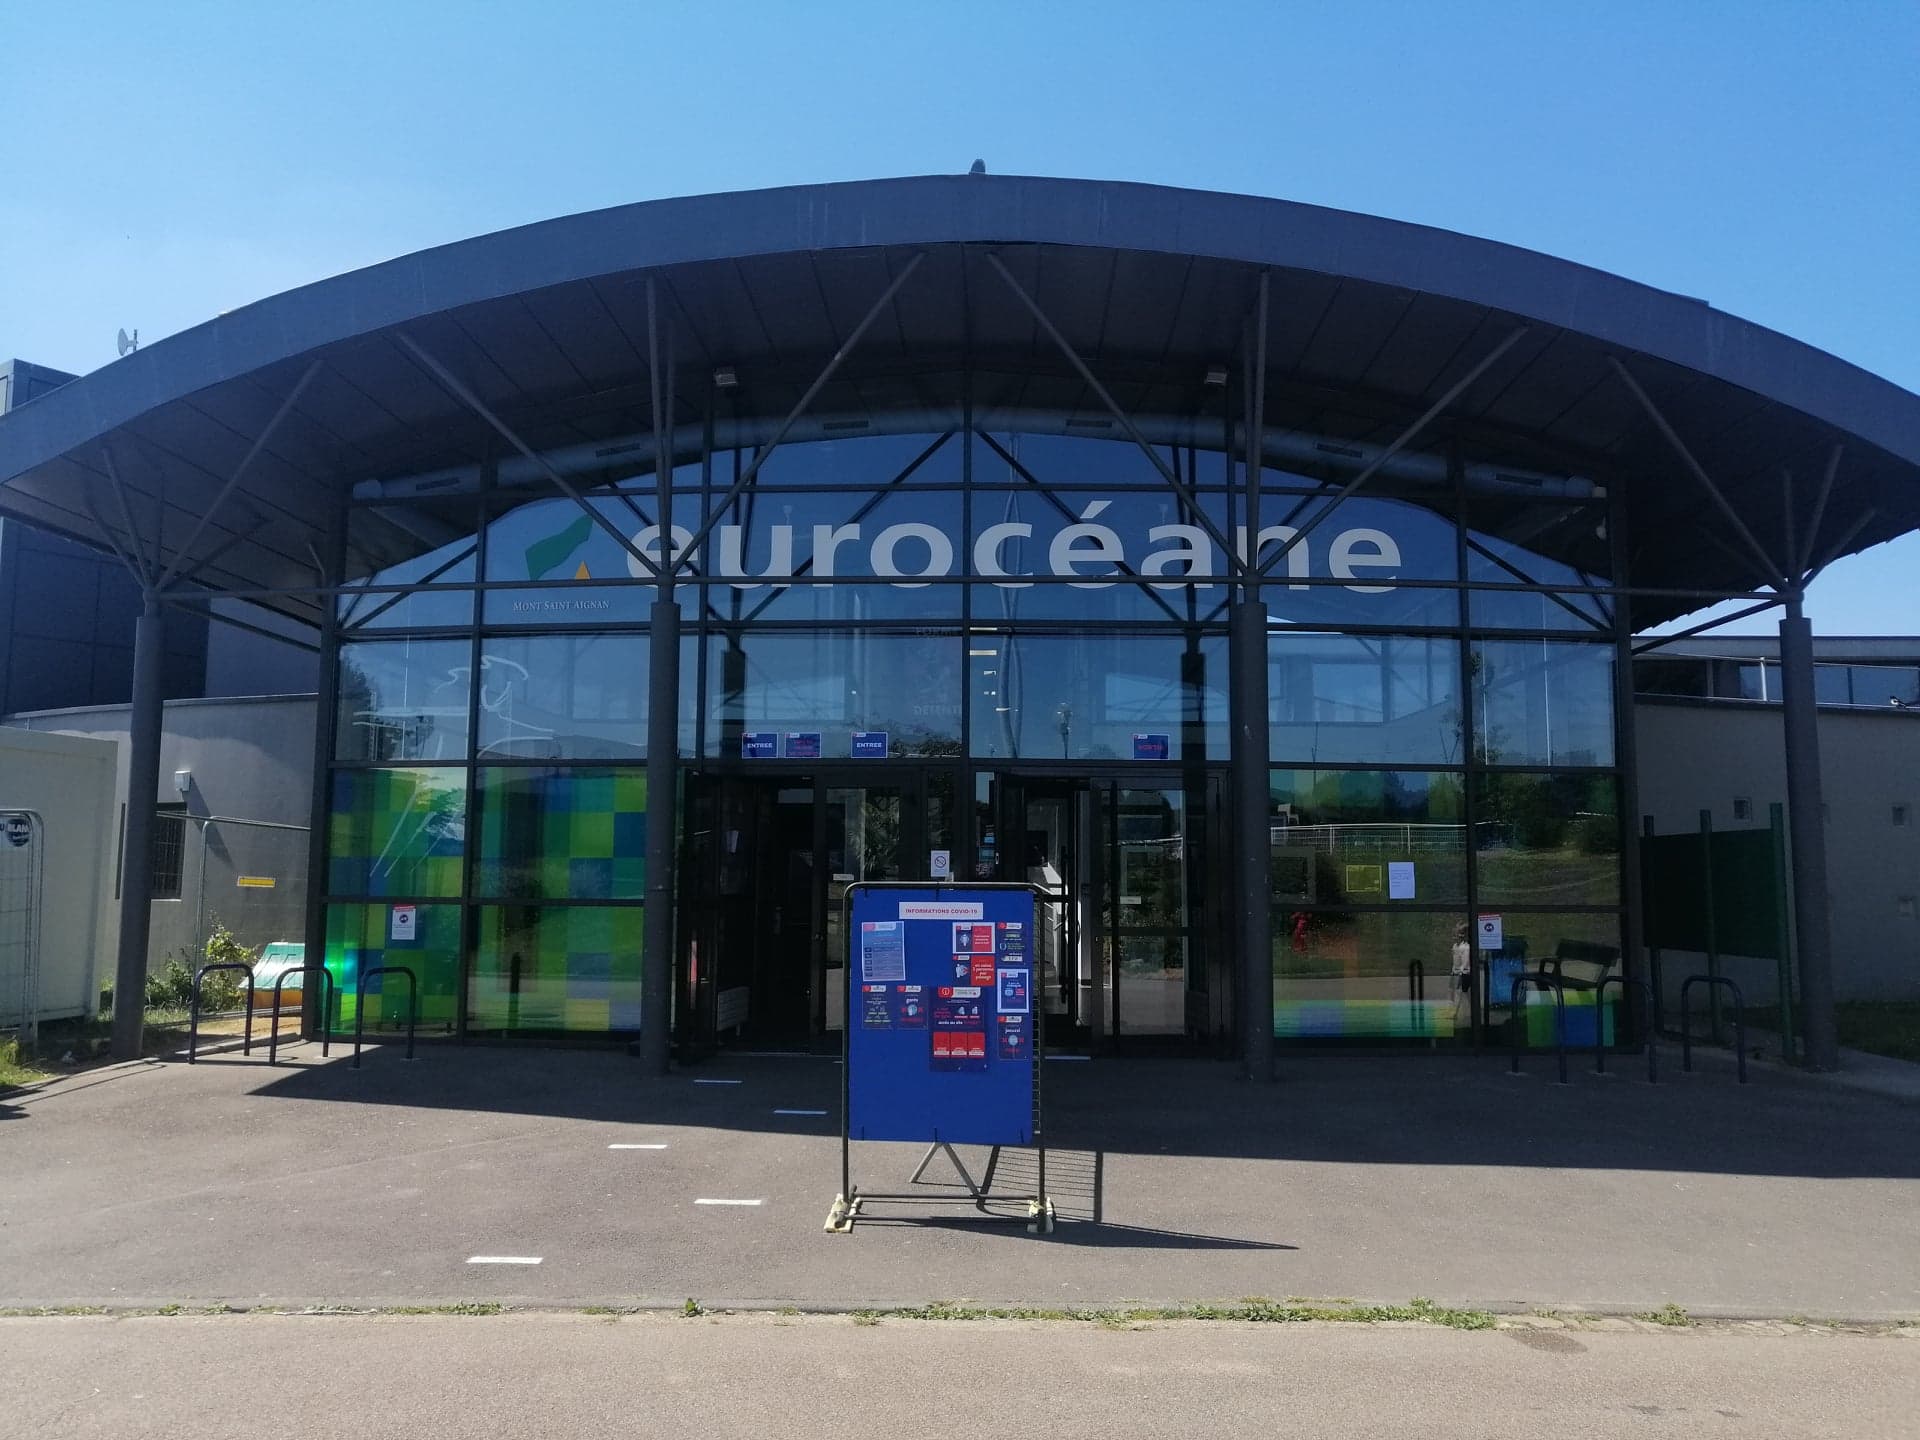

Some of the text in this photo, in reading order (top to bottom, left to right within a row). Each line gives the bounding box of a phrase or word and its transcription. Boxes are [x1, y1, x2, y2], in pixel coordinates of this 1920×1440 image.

[627, 501, 1401, 593] eurocéane
[513, 600, 609, 612] MONT SAINT AIGNAN
